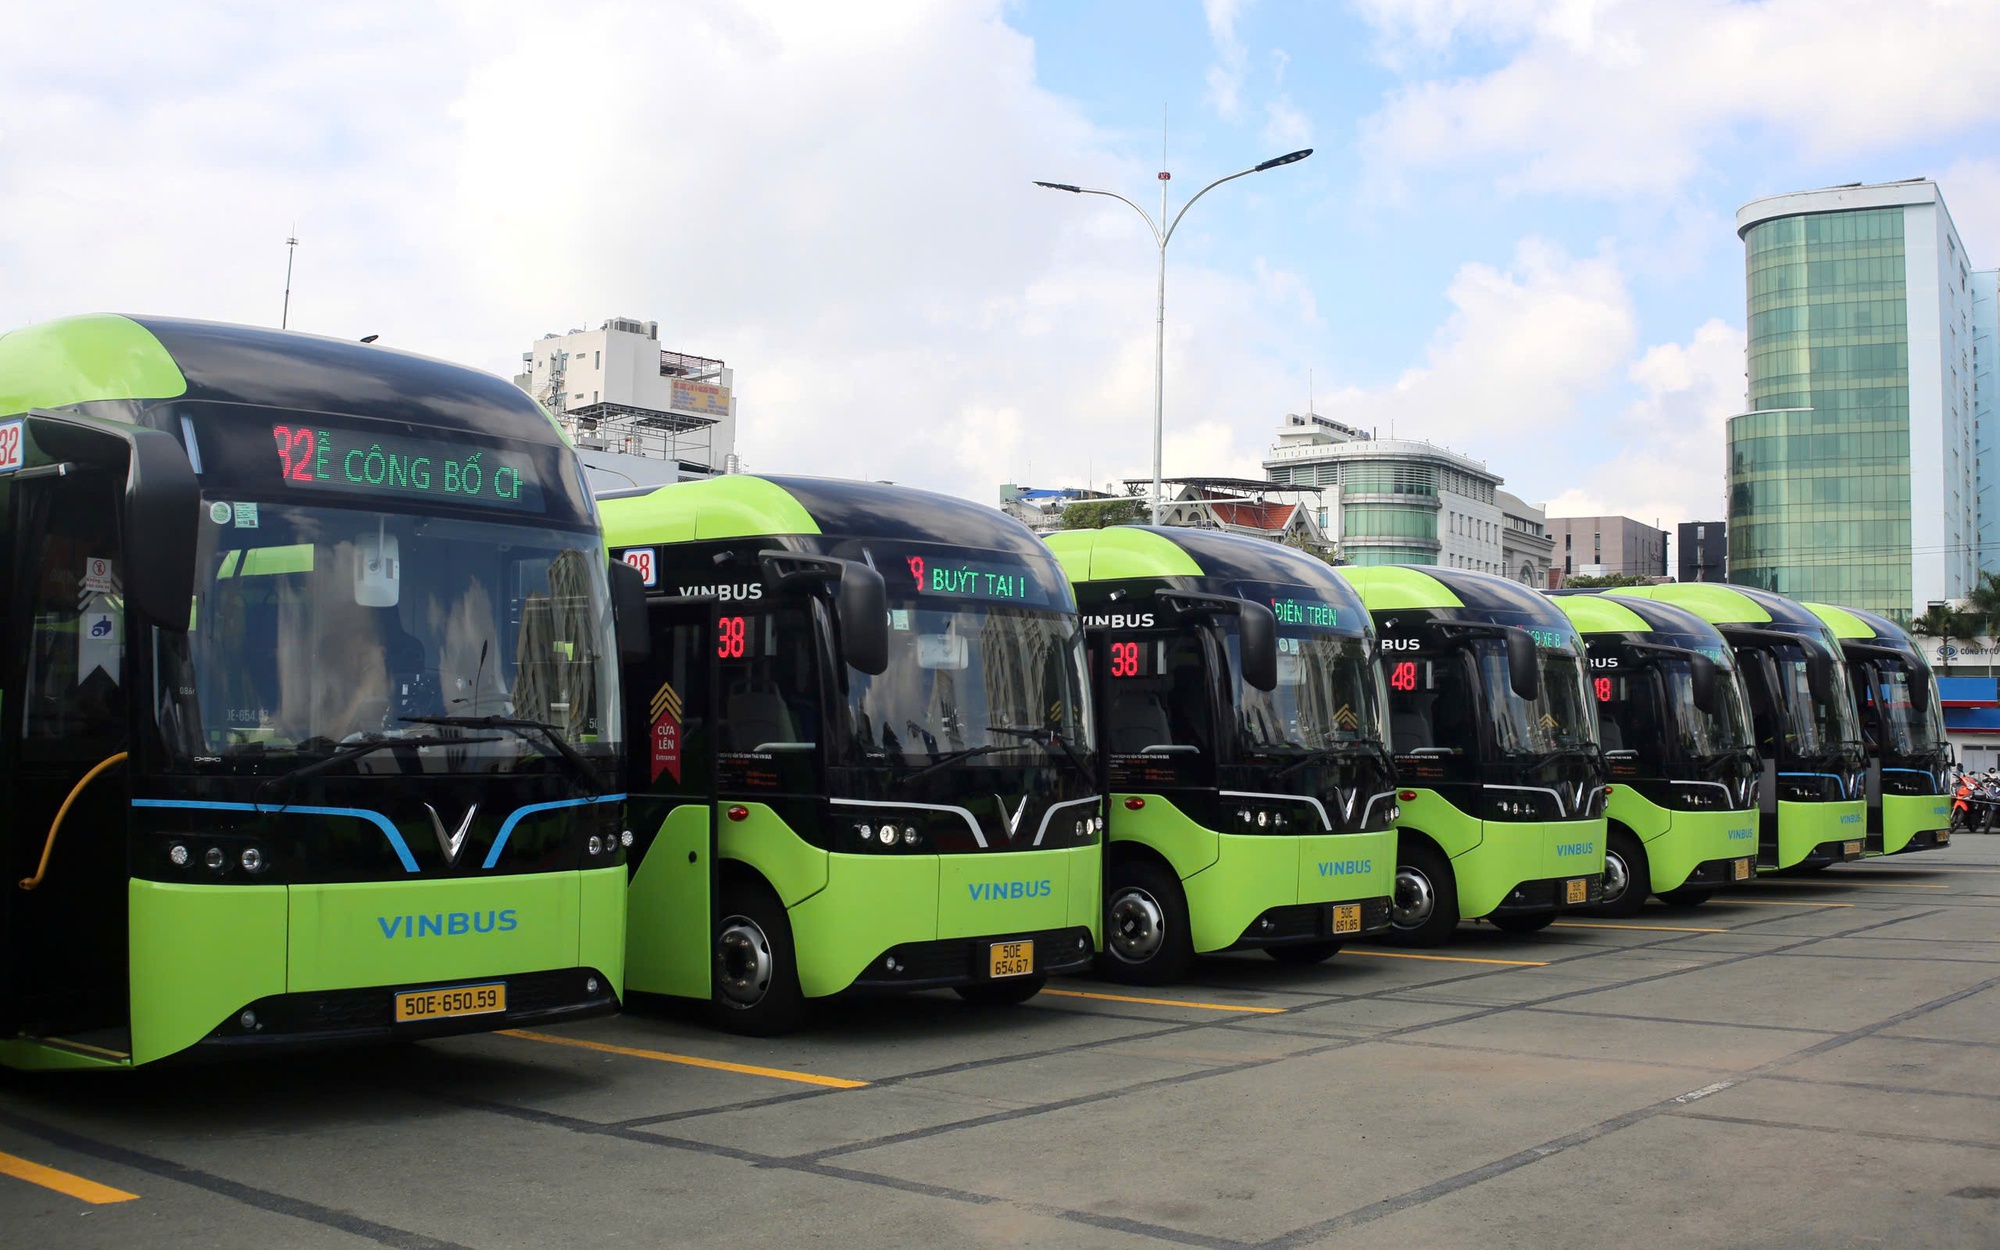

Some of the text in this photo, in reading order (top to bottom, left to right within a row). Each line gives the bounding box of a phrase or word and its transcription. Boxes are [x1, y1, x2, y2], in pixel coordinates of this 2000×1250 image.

[0, 426, 19, 466] 32
[344, 443, 430, 489] CÔNG
[444, 452, 482, 495] BỐ
[933, 565, 979, 593] BUÝT
[985, 574, 1013, 599] TẠI
[1307, 604, 1337, 626] TRÊN
[718, 616, 746, 658] 38
[1111, 642, 1138, 677] 38
[1391, 661, 1416, 691] 48
[657, 722, 675, 735] CỬA
[658, 737, 675, 750] LÊN
[1727, 828, 1753, 839] VINBUS
[1556, 842, 1593, 857] VINBUS
[1318, 859, 1372, 877] VINBUS
[968, 880, 1051, 901] VINBUS
[1341, 907, 1353, 919] 50E
[378, 909, 518, 939] VINBUS
[1003, 944, 1021, 959] 50E
[995, 958, 1029, 975] 654.67
[405, 989, 497, 1016] 50E-650.59
